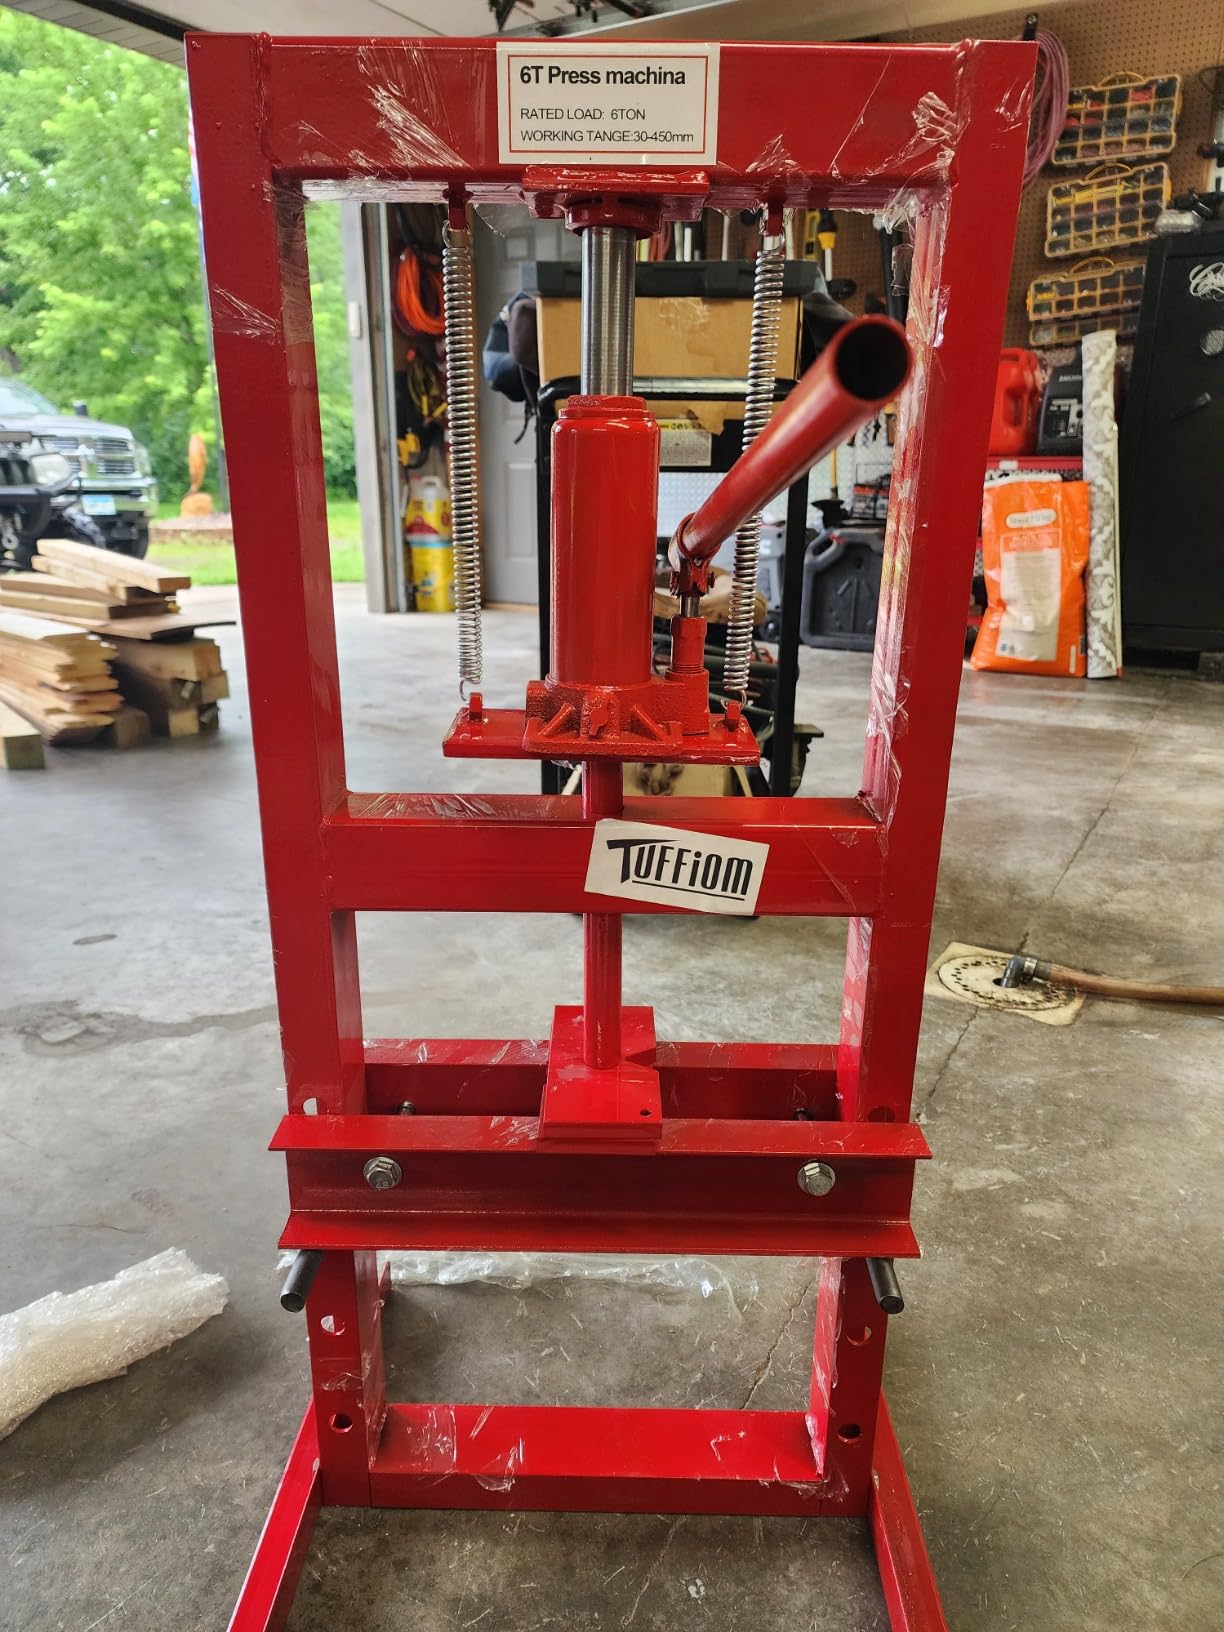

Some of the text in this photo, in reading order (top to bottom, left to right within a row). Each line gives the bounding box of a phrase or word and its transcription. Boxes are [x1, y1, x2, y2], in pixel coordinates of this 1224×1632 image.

[520, 65, 686, 85] 6T Press machina
[520, 108, 646, 120] RATED LOAD: 6TON
[520, 130, 694, 143] WORKING TANGE:30-450mm
